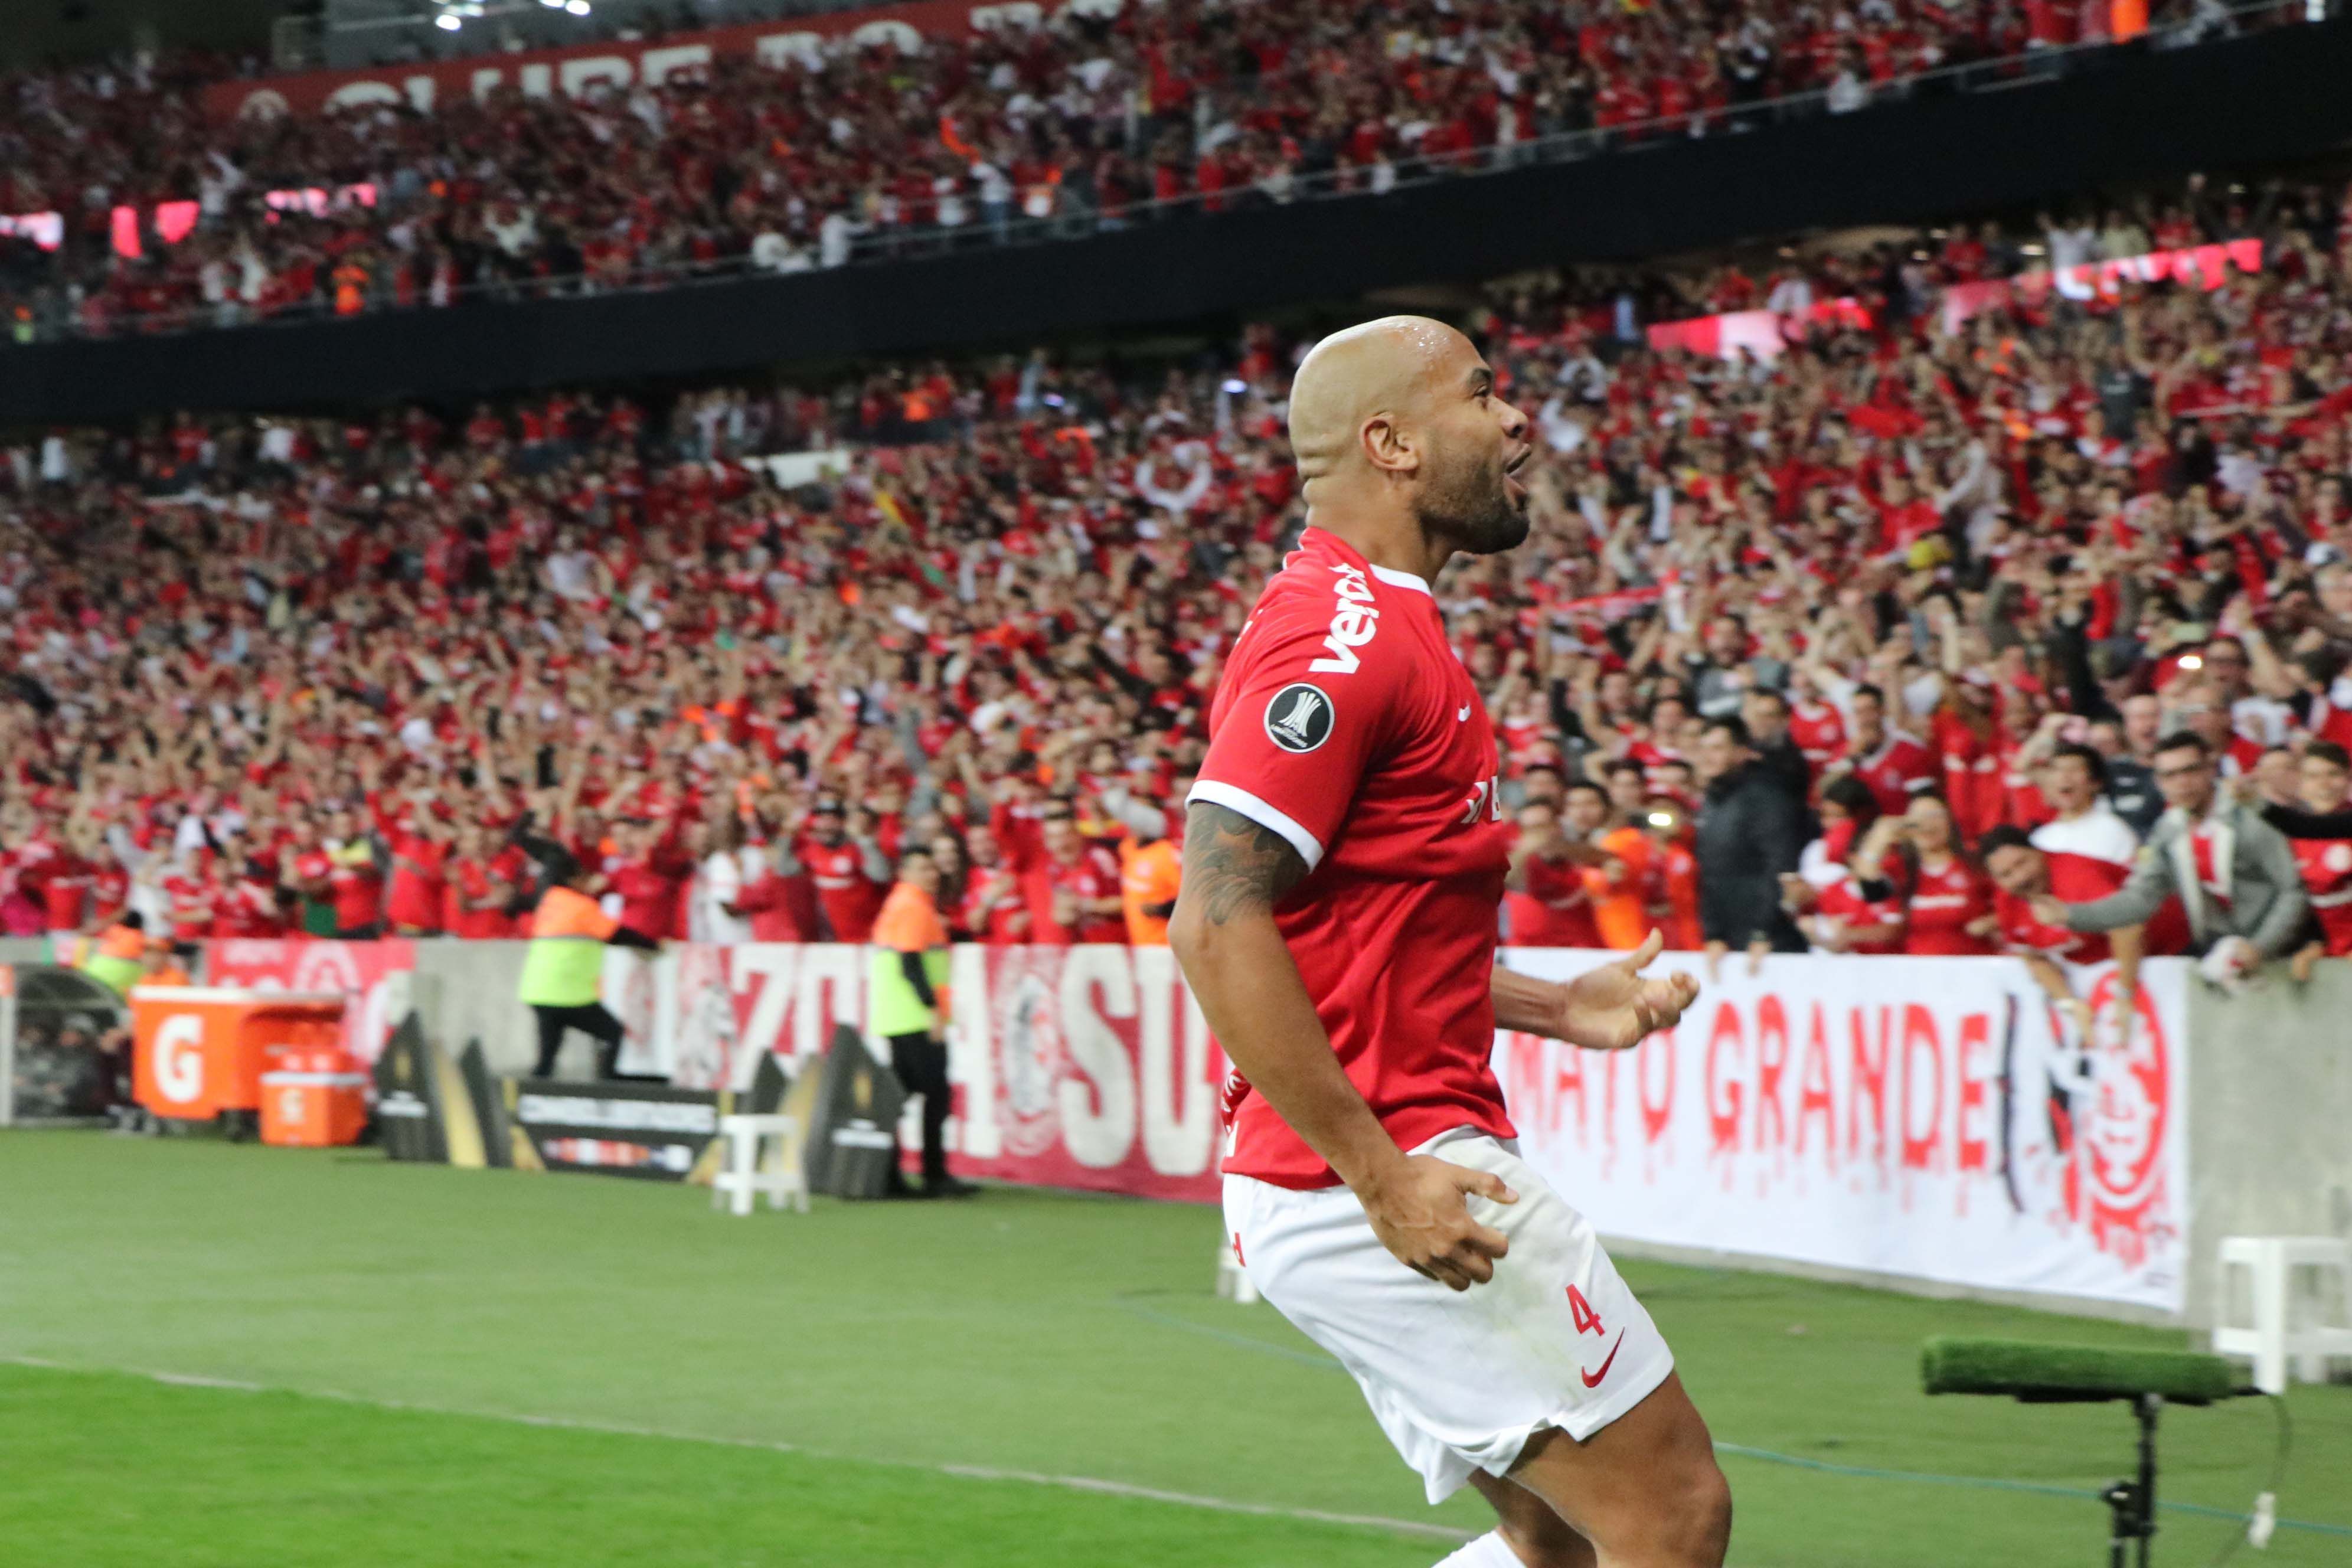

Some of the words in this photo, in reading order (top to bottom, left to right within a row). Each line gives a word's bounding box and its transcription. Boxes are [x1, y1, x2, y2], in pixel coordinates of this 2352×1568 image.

[152, 1013, 205, 1104] G
[1703, 993, 1991, 1174] GRANDE
[1565, 1283, 1605, 1337] 4
